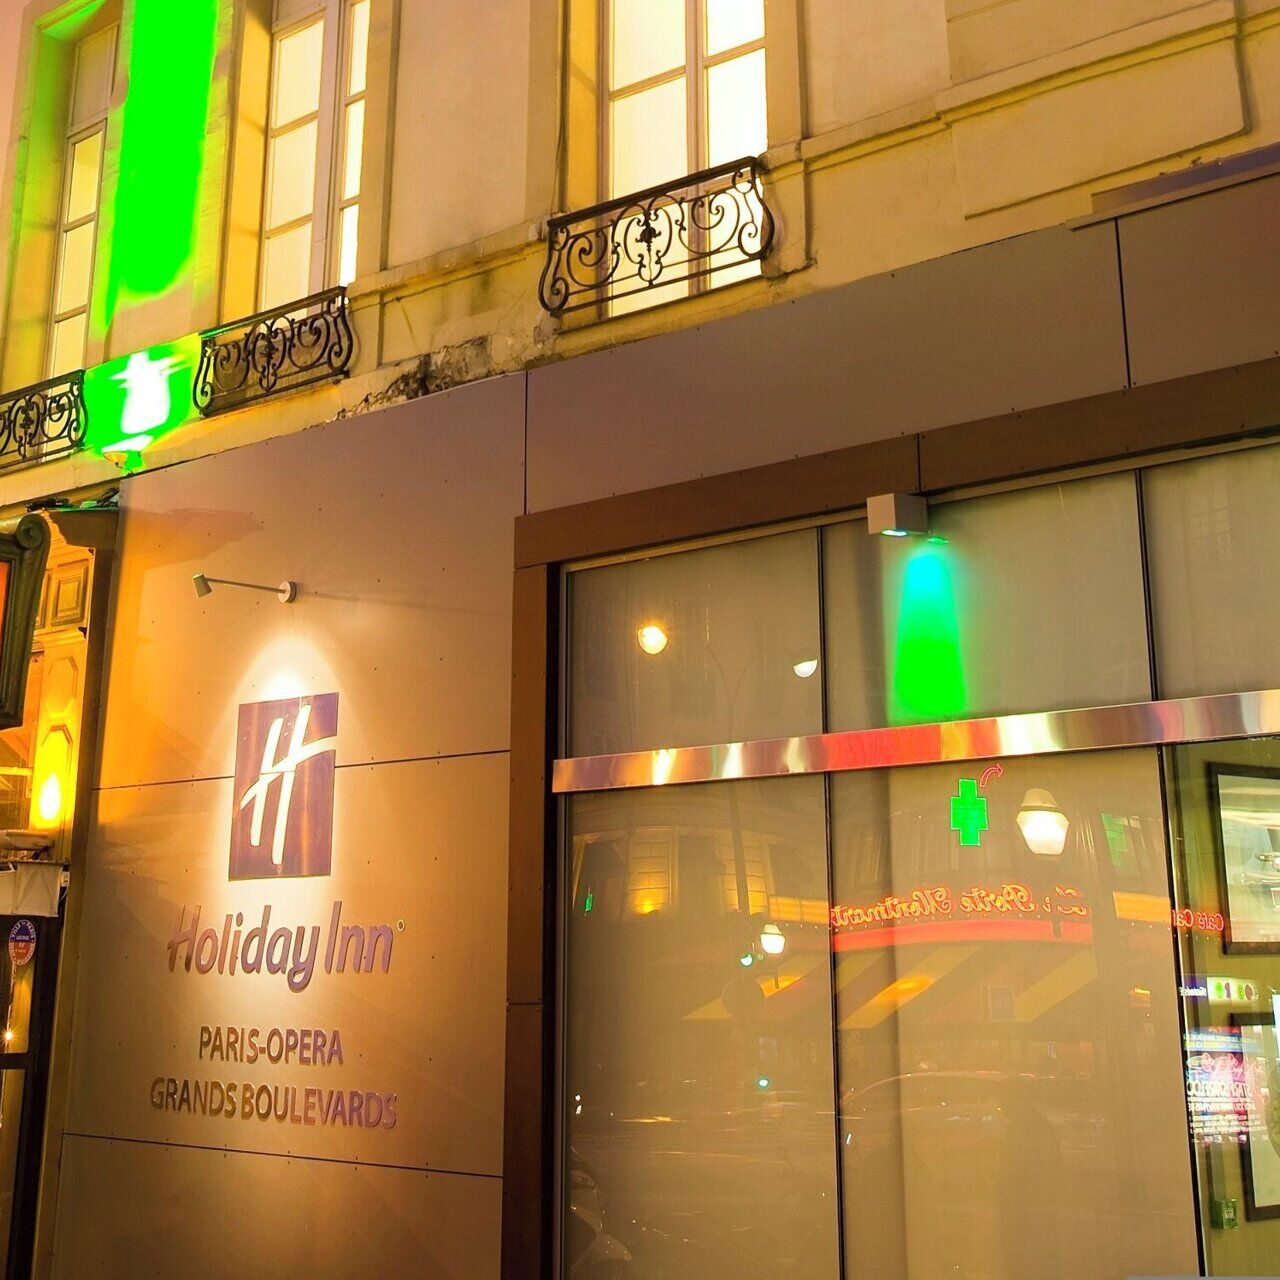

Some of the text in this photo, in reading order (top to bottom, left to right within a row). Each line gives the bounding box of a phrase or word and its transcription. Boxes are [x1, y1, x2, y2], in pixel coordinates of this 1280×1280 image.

[167, 899, 395, 993] Holiday Inn
[198, 1024, 344, 1066] PARIS-OPERA
[150, 1076, 398, 1130] GRANDS BOULEVARDS
